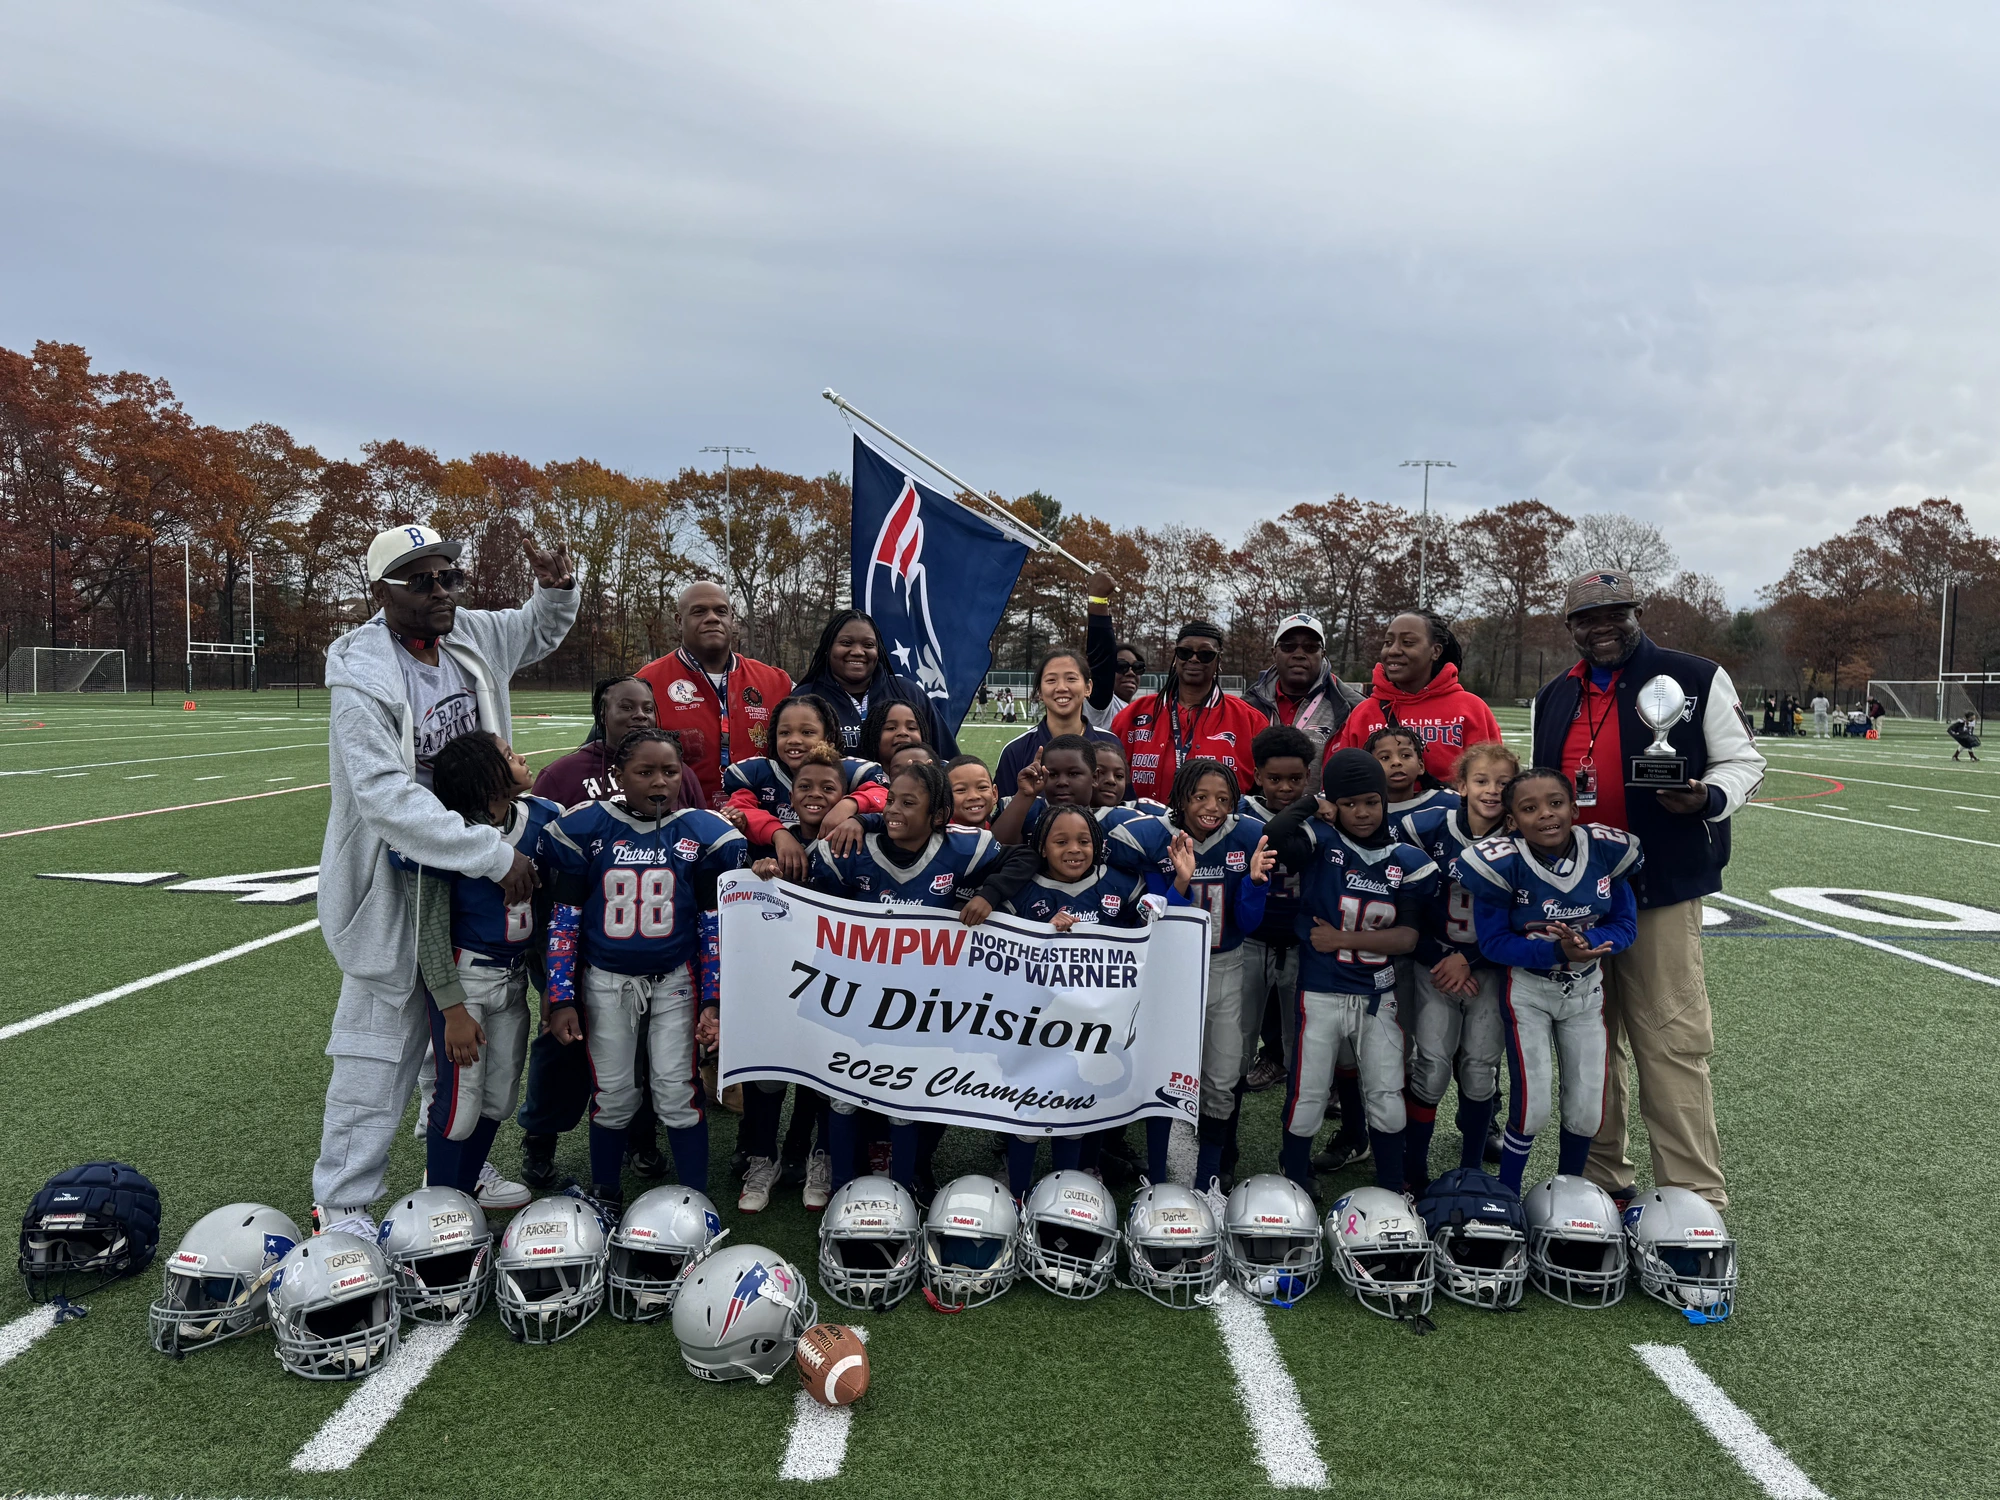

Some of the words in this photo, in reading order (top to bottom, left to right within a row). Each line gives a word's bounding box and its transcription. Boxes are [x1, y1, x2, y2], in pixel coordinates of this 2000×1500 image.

[404, 527, 425, 548] B
[185, 701, 193, 710] 10
[436, 700, 462, 727] BJP
[1868, 731, 1877, 739] 20
[612, 845, 667, 864] Patrios
[936, 874, 953, 882] POP
[1190, 866, 1224, 880] atriots
[1346, 874, 1389, 895] Patriots
[602, 868, 676, 940] 88
[723, 891, 752, 905] NMPW
[1542, 904, 1592, 920] Patriots
[816, 914, 968, 966] NMPW
[971, 931, 1104, 964] NORTHEASTERN
[1108, 949, 1137, 964] MA
[968, 946, 1020, 976] POP
[1025, 961, 1138, 988] WARNER
[788, 960, 862, 1018] 7U
[868, 987, 1112, 1054] Division
[828, 1052, 918, 1090] 2025
[924, 1066, 1098, 1112] Champions
[1064, 1190, 1100, 1208] QUILLAN
[844, 1200, 899, 1214] NATALIA
[432, 1213, 467, 1228] ISAIAH
[952, 1216, 974, 1226] Riddell
[1070, 1209, 1092, 1220] Riddell
[1379, 1218, 1401, 1230] JJ
[1572, 1220, 1594, 1228] Riddell
[440, 1230, 462, 1241] Riddell
[632, 1228, 652, 1238] Riddell
[532, 1246, 556, 1255] Riddell
[332, 1252, 365, 1268] QASIM
[340, 1274, 366, 1288] Riddell
